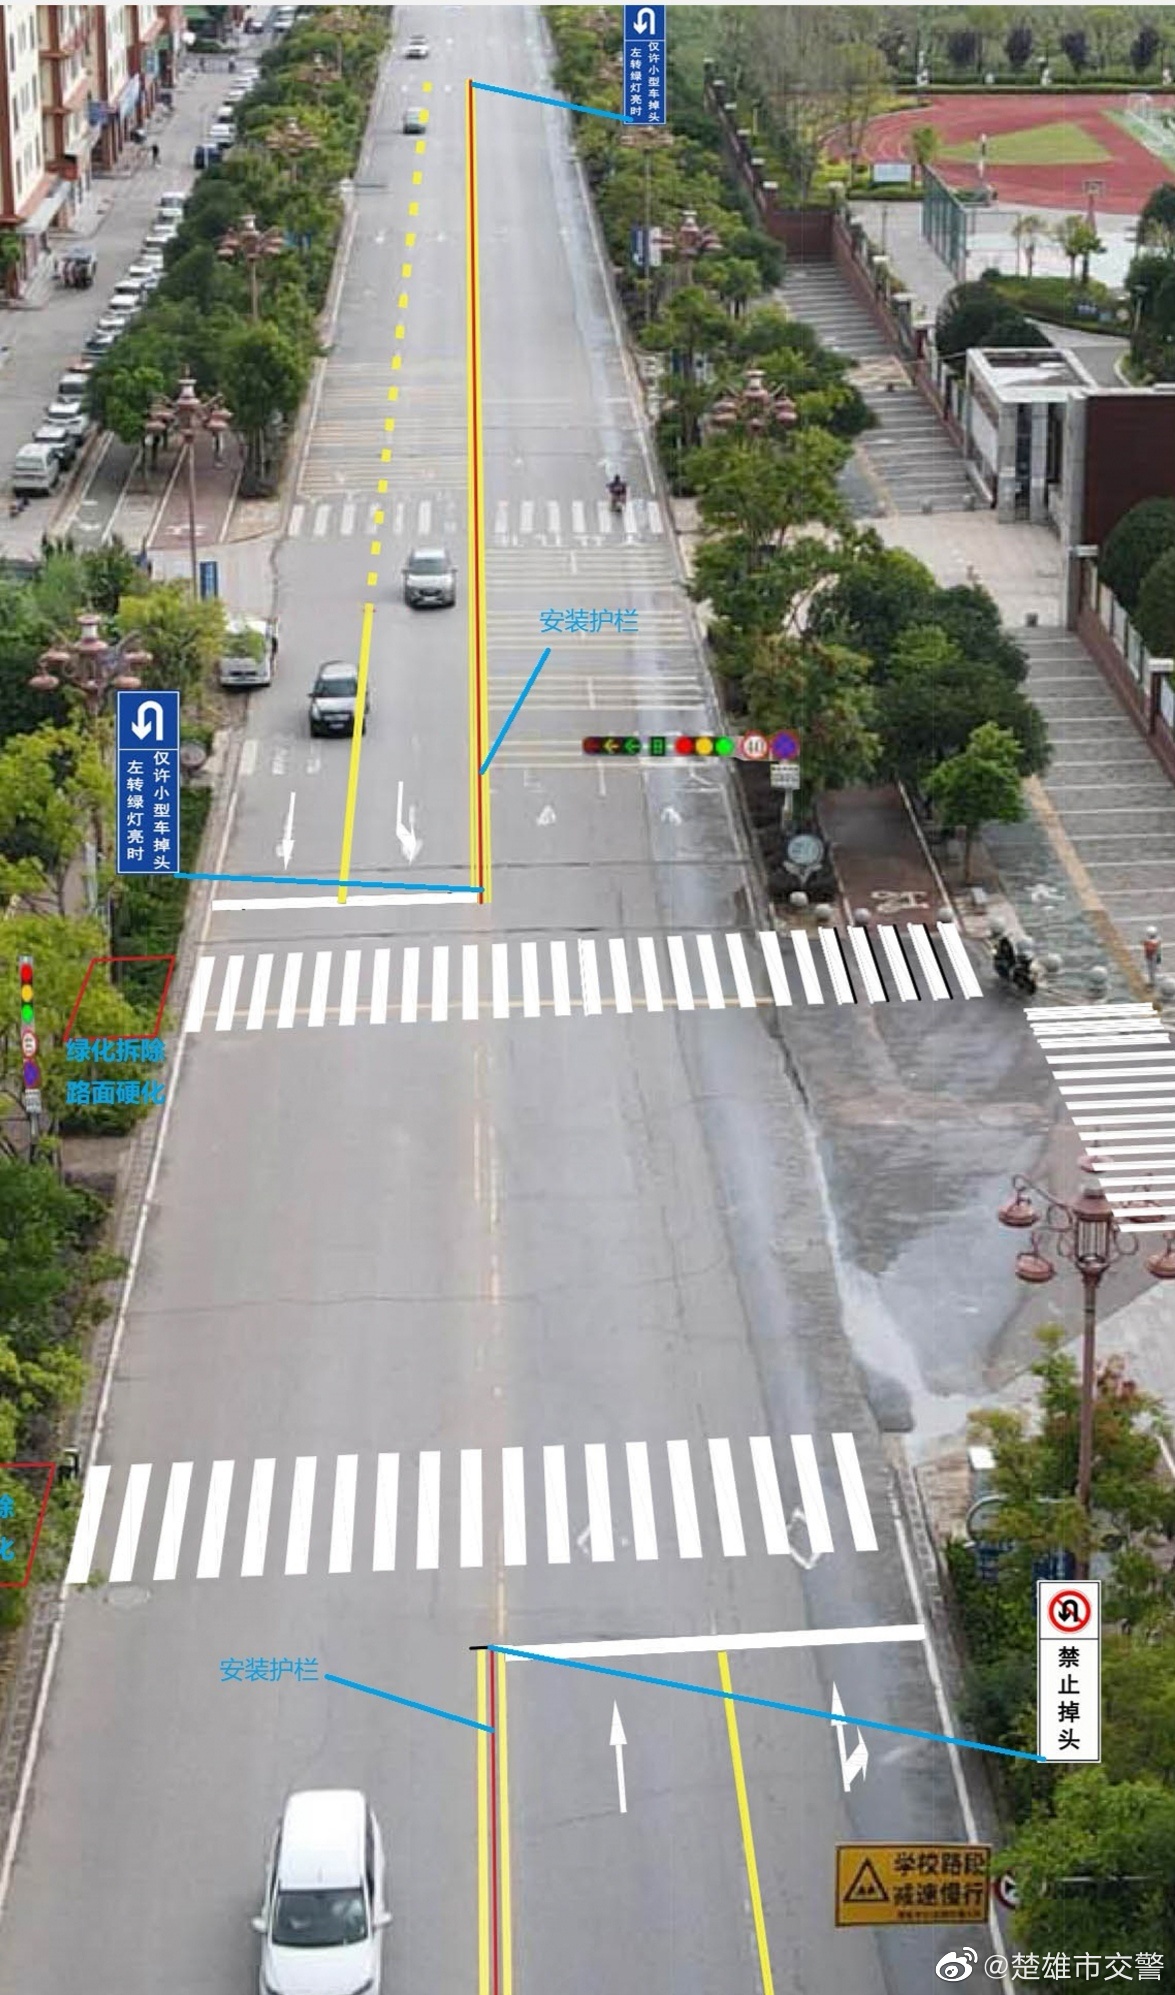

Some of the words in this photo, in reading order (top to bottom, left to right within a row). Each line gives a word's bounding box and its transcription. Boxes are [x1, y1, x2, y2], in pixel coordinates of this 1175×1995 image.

[630, 47, 642, 116] 左转绿灯亮时
[648, 41, 660, 122] 仅许小型车掉头
[126, 760, 144, 861] 左转绿灯亮时
[153, 751, 171, 870] 仅许小型车掉头
[1058, 1646, 1080, 1750] 禁止掉头
[893, 1852, 986, 1876] 学校路段
[893, 1882, 983, 1906] 减速慢行
